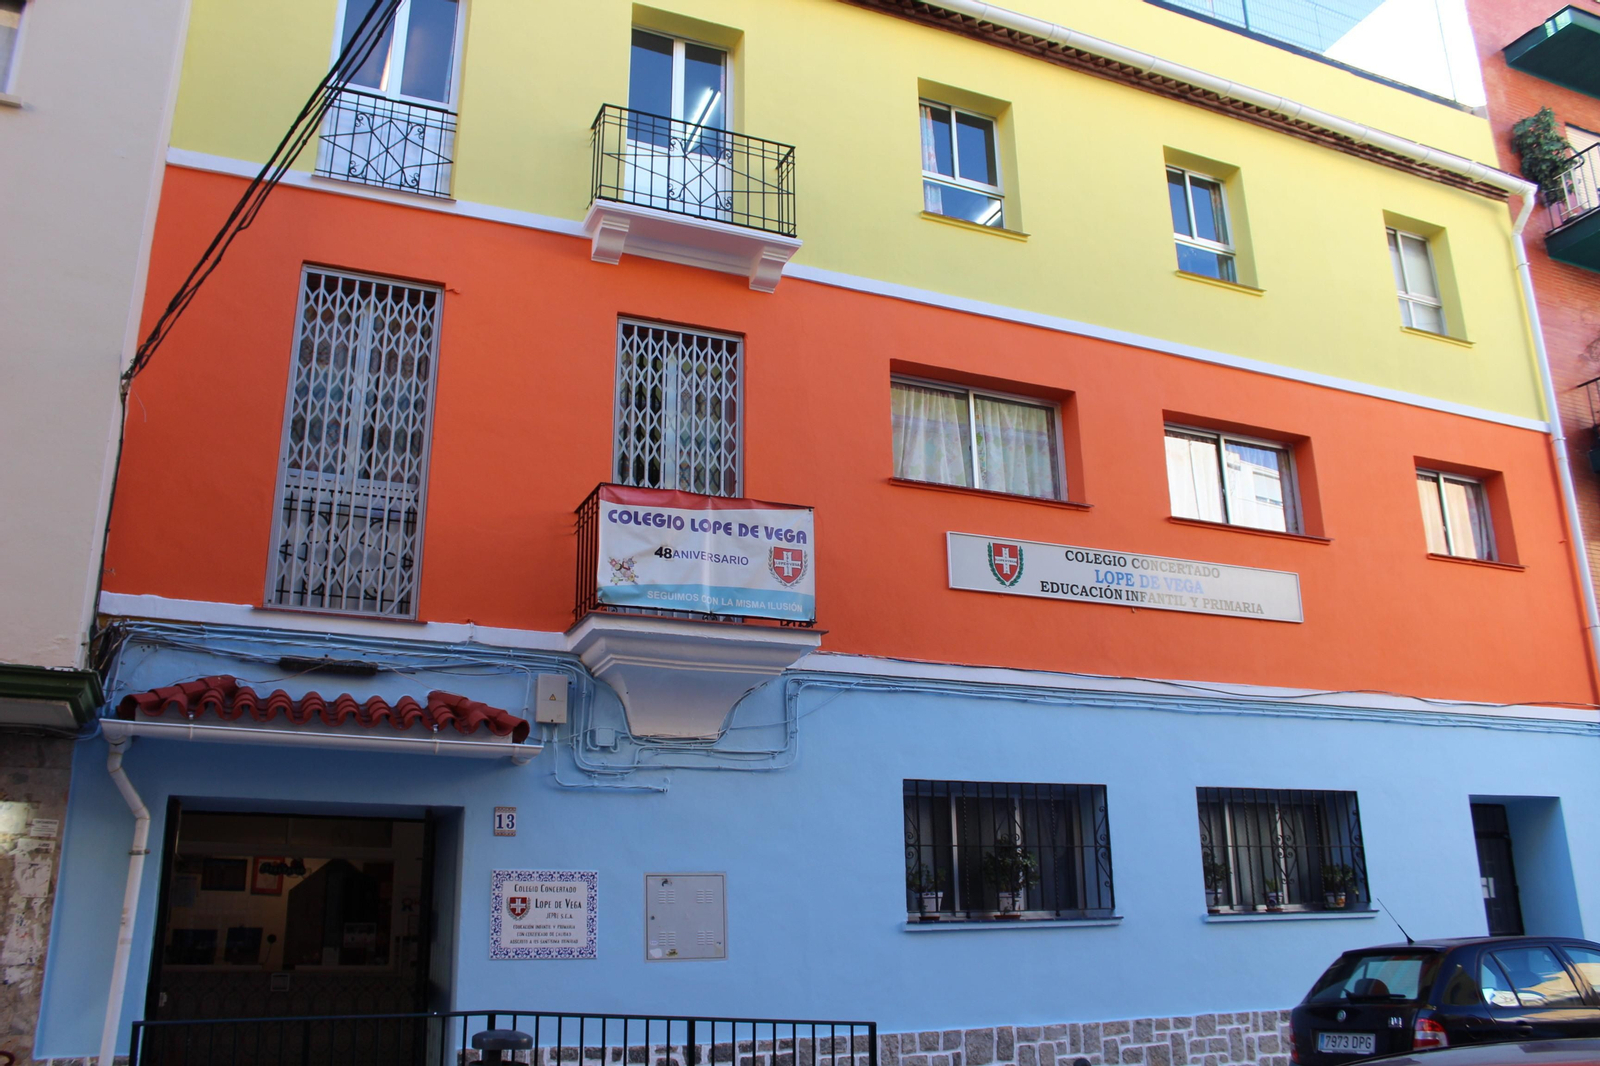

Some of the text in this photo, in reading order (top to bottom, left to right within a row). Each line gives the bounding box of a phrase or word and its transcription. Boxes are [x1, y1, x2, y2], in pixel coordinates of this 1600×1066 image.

[608, 509, 807, 544] COLEGIO LOPE DE VEGA
[1065, 550, 1221, 579] COLEGIO CONCERTADO
[1094, 569, 1205, 594] LOPE DE VEGA
[647, 590, 803, 613] SEGUIMOS CON LA MISMA ILUSIÓN
[1040, 580, 1265, 615] EDUCACIÓN INFANTIL Y PRIMARIA
[496, 813, 515, 830] 13
[535, 898, 551, 909] LOPE
[565, 898, 582, 909] VEGA
[1325, 1035, 1372, 1049] 7973 DPG
